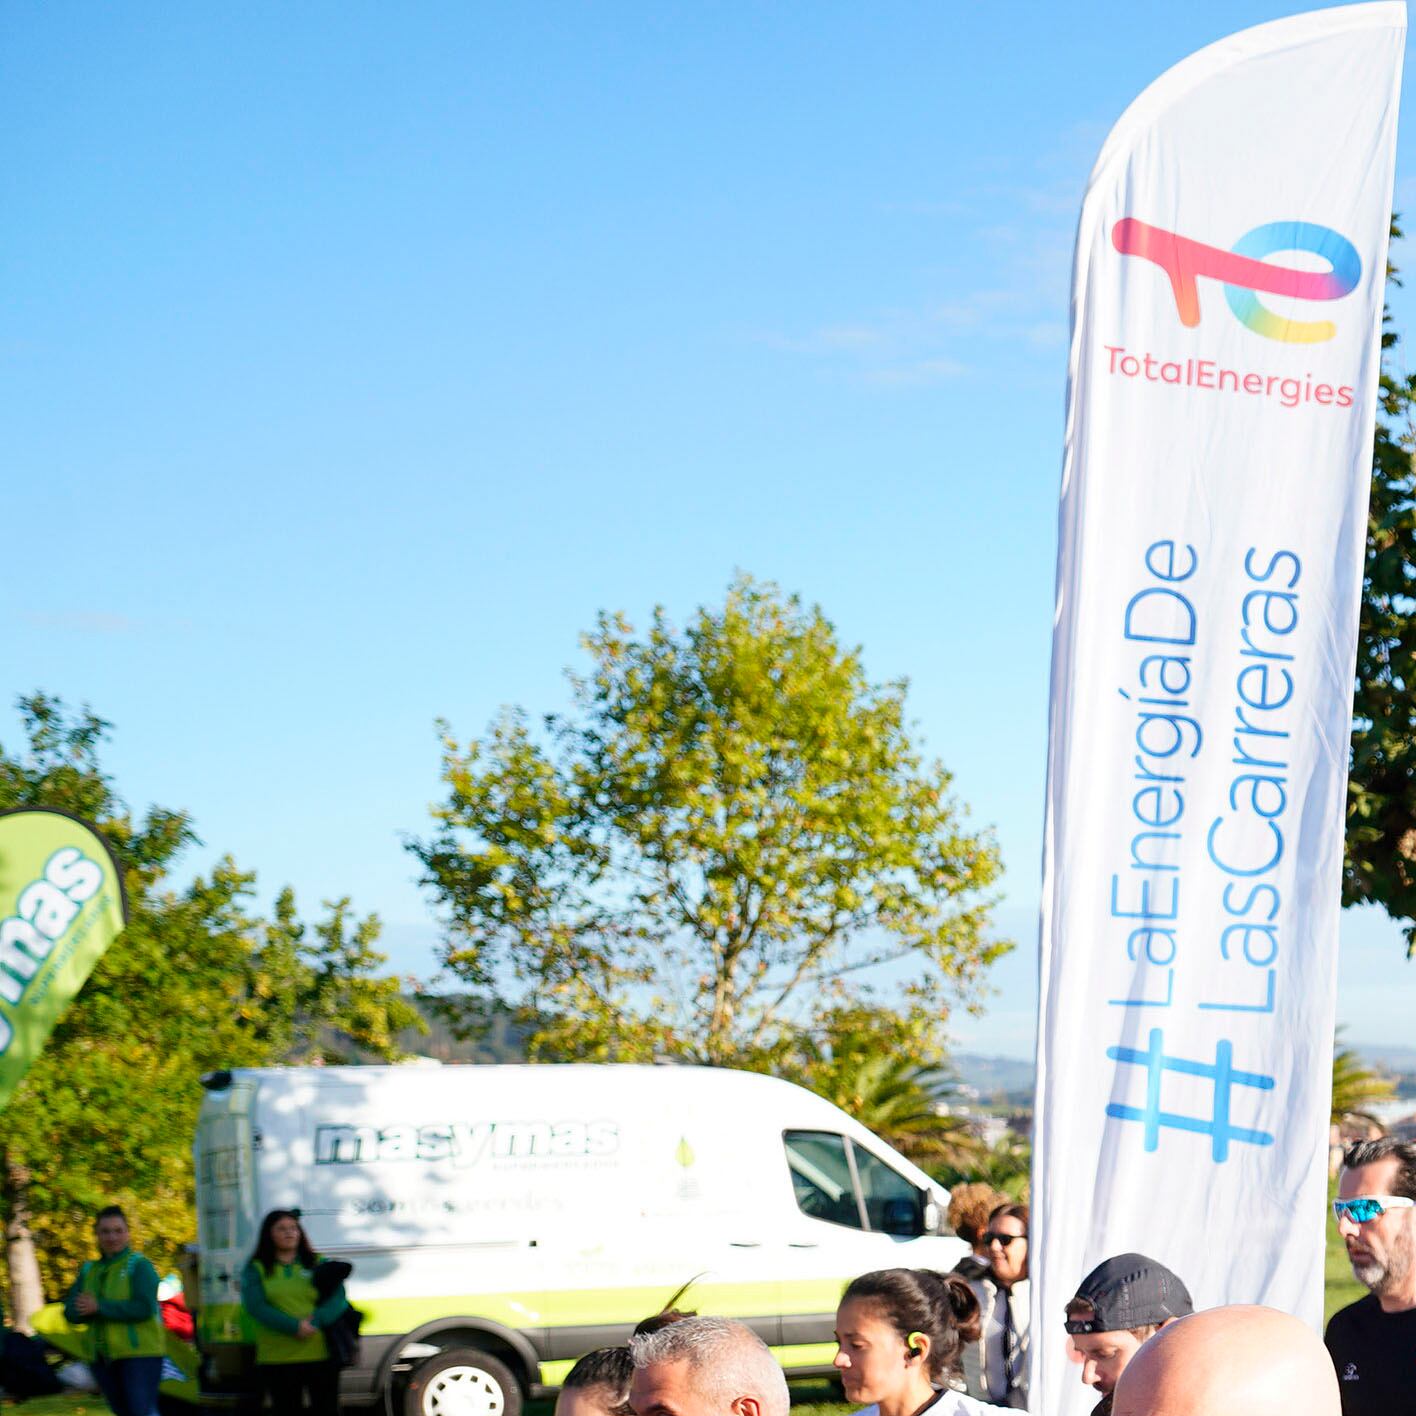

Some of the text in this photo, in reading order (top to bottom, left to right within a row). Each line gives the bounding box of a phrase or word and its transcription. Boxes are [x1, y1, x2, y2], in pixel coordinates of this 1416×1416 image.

[1104, 345, 1354, 408] TotalEnergies
[1198, 547, 1303, 1014] LasCarreras
[314, 1120, 624, 1170] masymas
